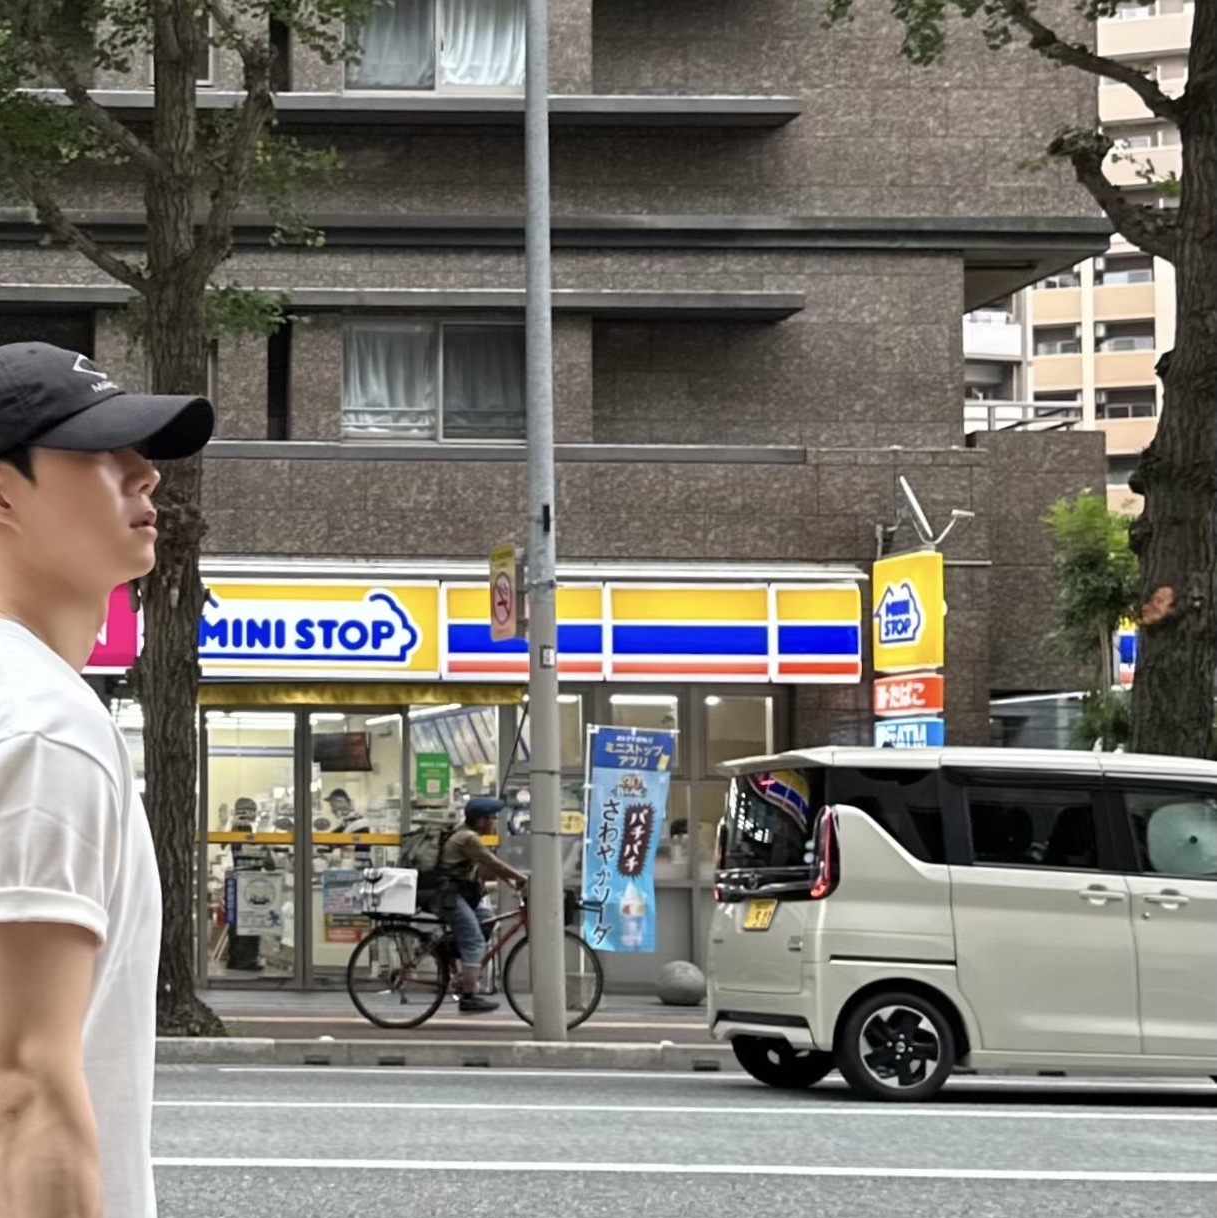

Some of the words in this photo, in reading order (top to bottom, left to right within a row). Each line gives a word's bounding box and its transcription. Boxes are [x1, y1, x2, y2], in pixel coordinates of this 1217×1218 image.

[198, 618, 286, 649] MINI
[294, 618, 396, 651] STOP
[884, 618, 912, 638] STOP
[623, 808, 650, 873] パチパチ
[593, 799, 621, 946] さわやかソーダ
